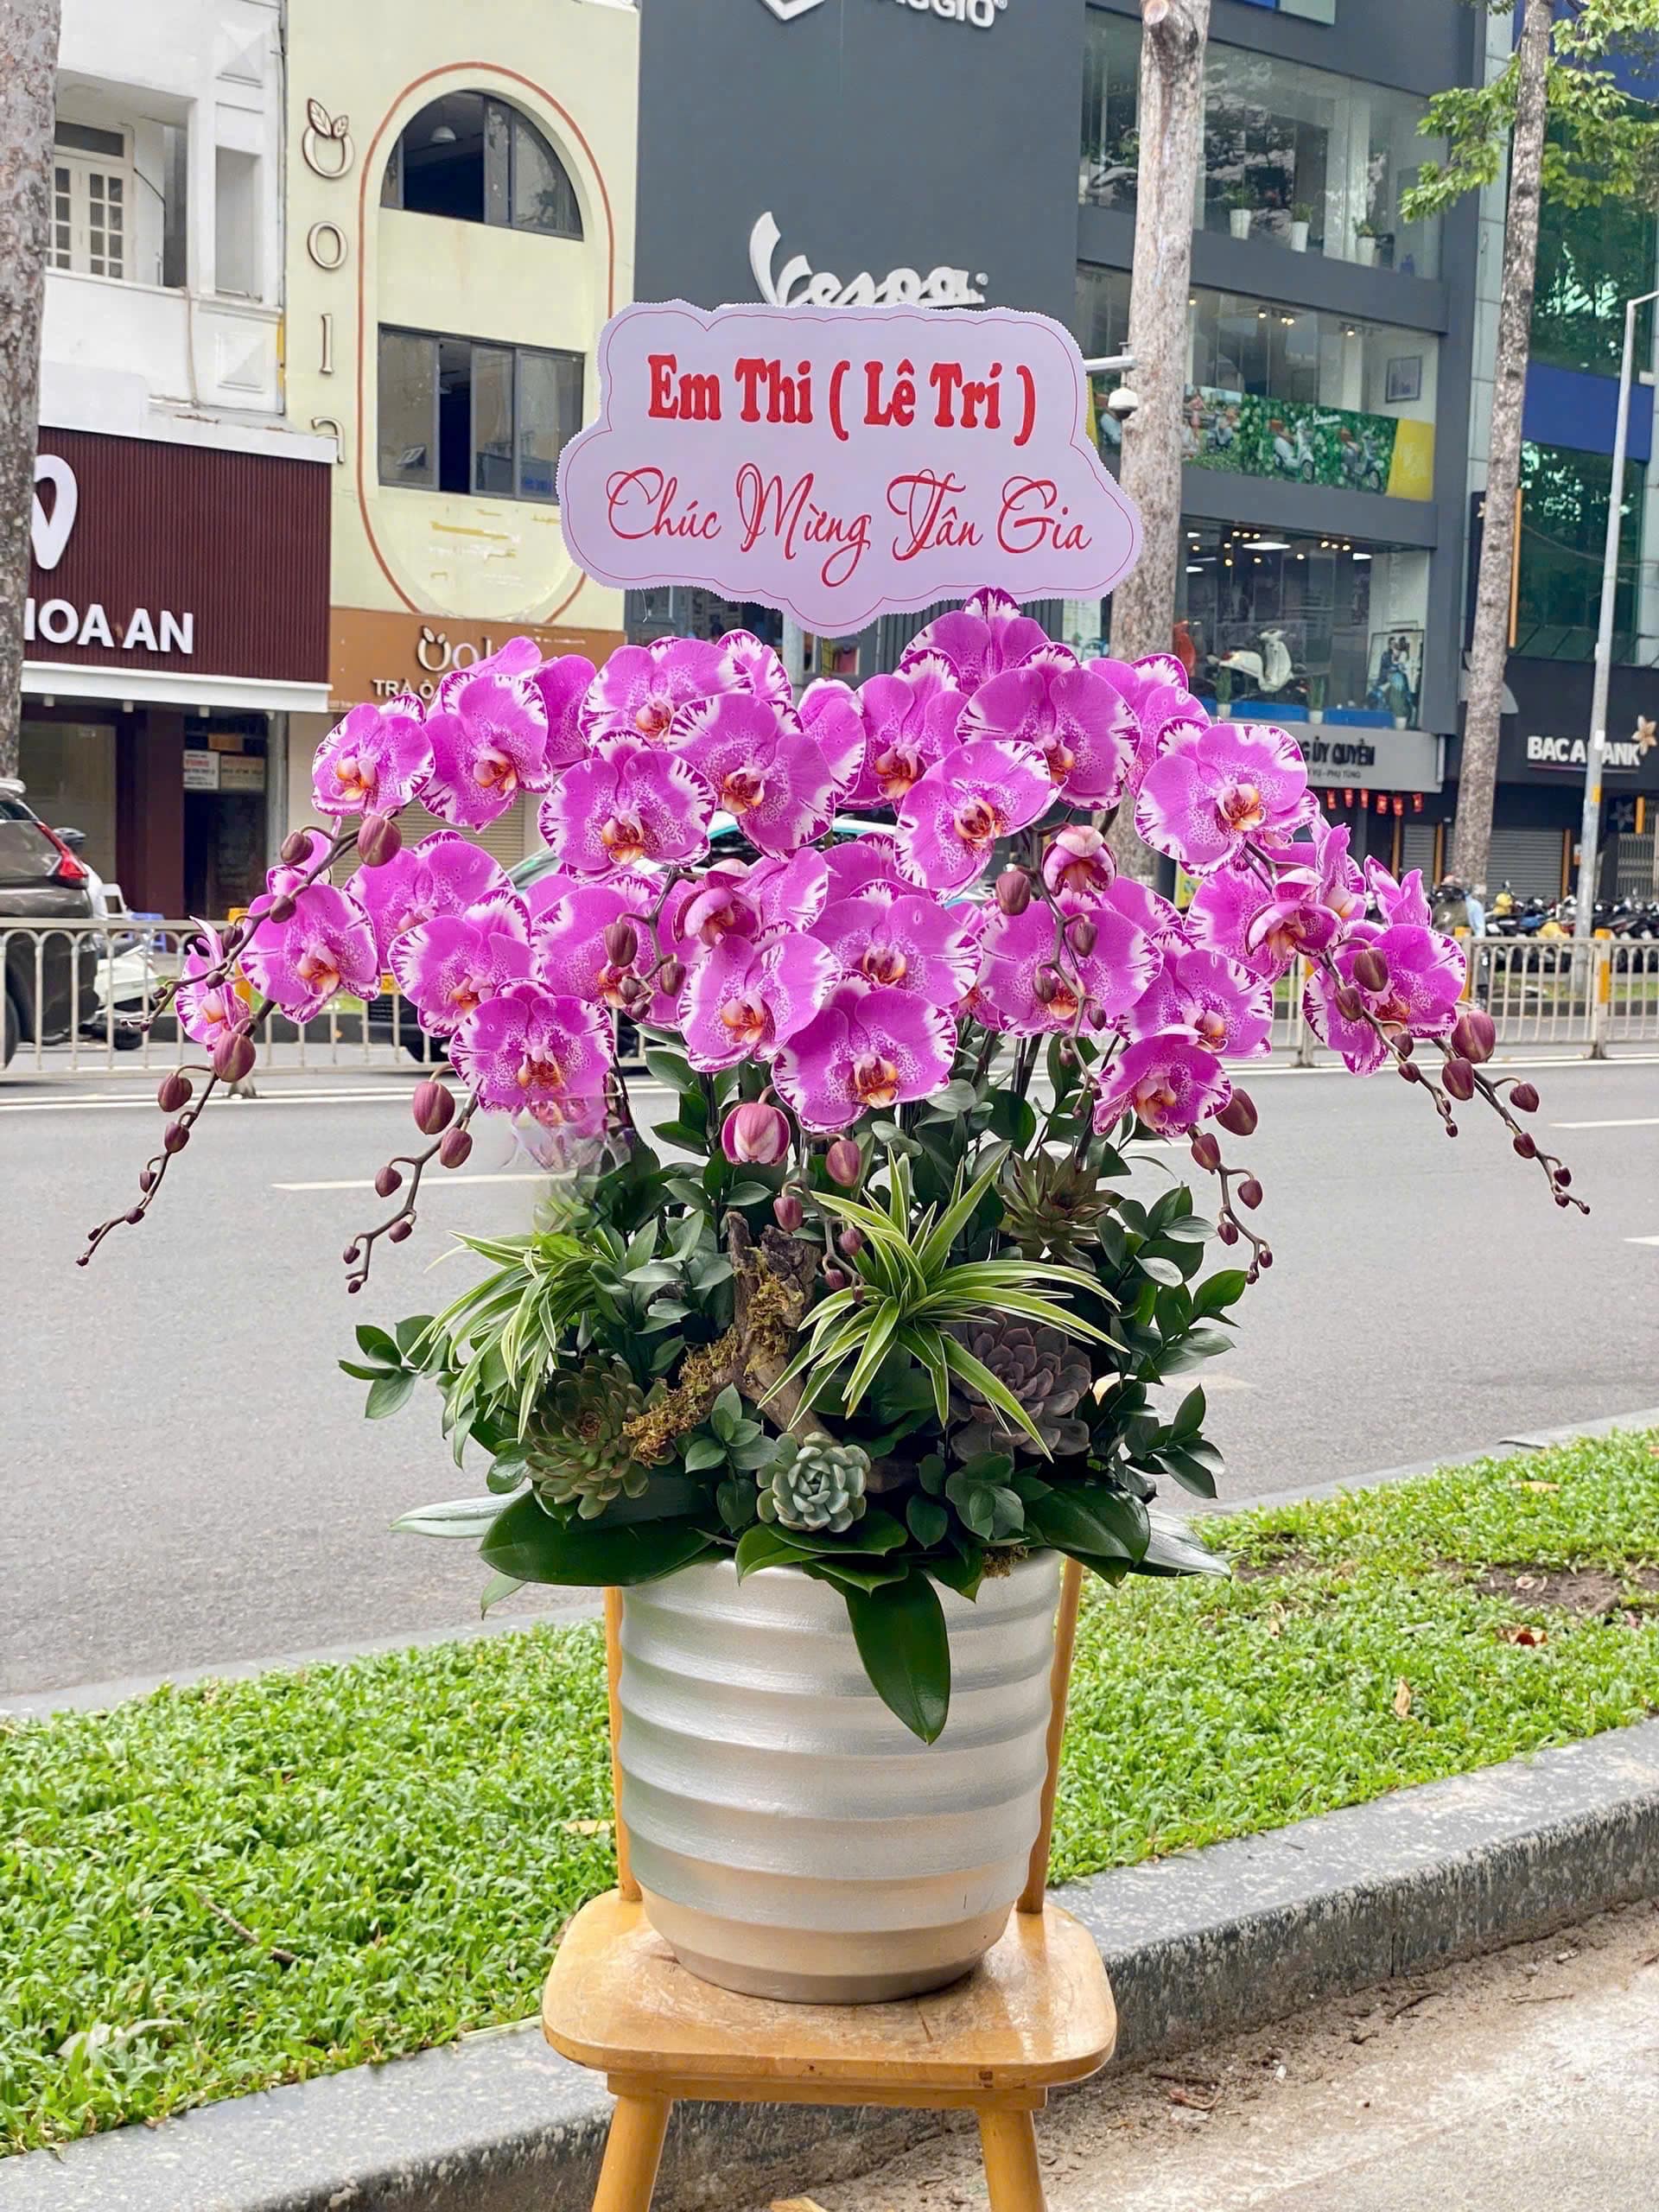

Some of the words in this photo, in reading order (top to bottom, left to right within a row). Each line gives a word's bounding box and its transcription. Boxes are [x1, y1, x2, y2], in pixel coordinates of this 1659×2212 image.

[647, 354, 721, 421] Em
[734, 358, 813, 424] Thi
[864, 359, 916, 427] Lê
[930, 363, 1002, 429] Trí
[607, 467, 721, 540] Chúc
[735, 462, 871, 588] Mừng
[887, 468, 983, 562] Tân
[996, 476, 1092, 555] Gia
[123, 607, 194, 654] AN
[1528, 736, 1570, 762] BAC
[1569, 740, 1586, 763] A
[1588, 741, 1641, 766] ANK
